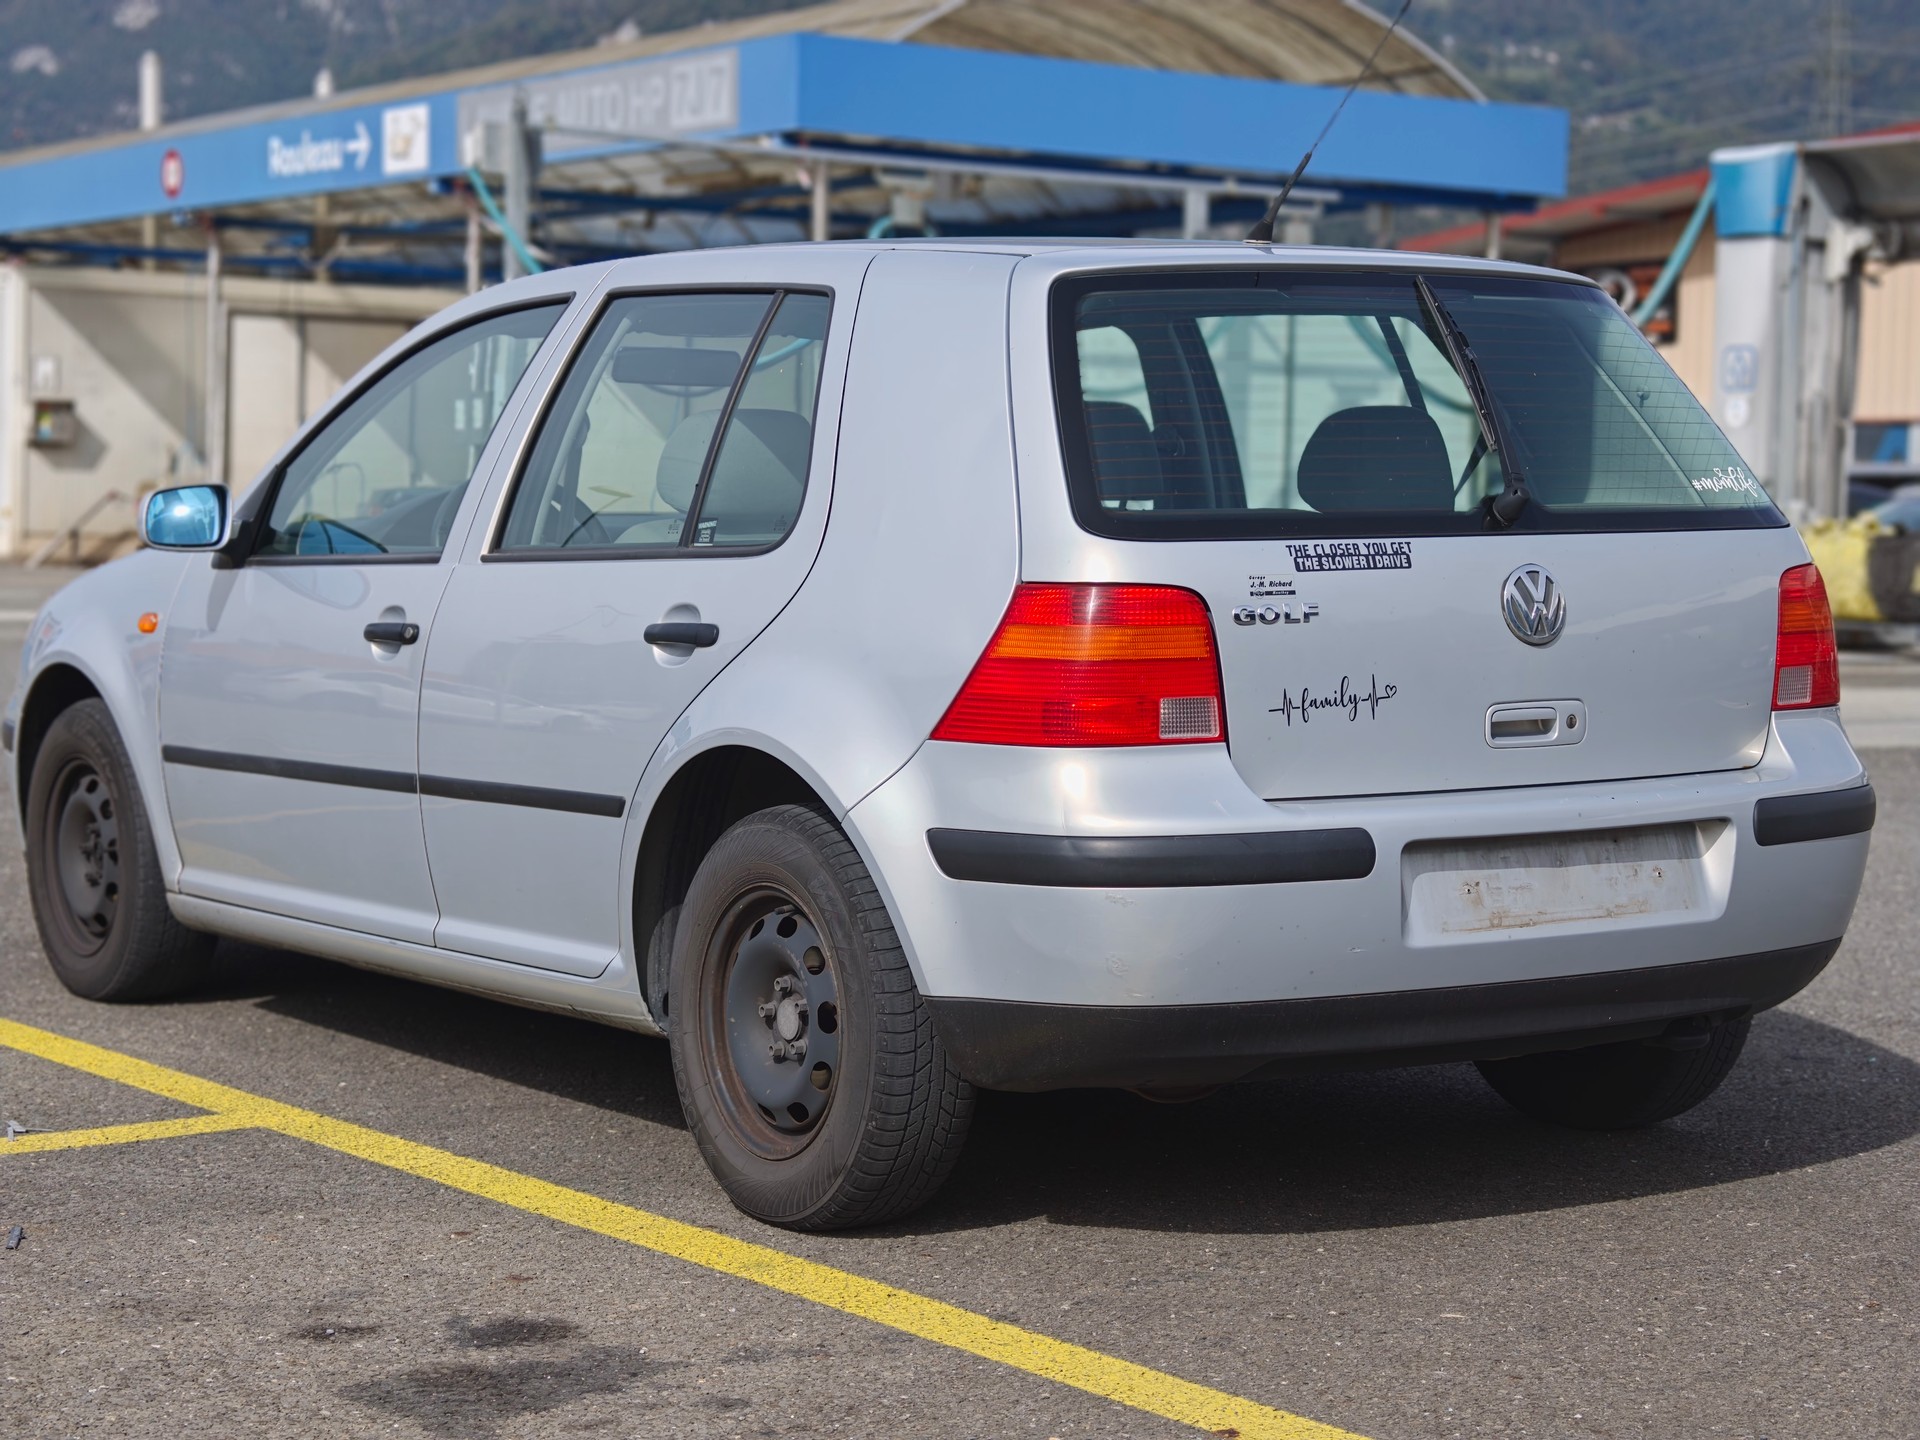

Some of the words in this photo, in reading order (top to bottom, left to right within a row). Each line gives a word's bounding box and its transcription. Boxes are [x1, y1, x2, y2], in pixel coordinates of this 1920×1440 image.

[1285, 544, 1311, 557] THE
[1313, 543, 1360, 556] CLOSER
[1362, 542, 1388, 555] YOU
[1390, 541, 1412, 554] GET
[1297, 557, 1320, 571] THE
[1322, 555, 1368, 570] SLOWER
[1376, 554, 1409, 568] DRIVE
[1269, 580, 1293, 588] Richard
[1231, 602, 1319, 626] GOLF
[1301, 675, 1361, 724] family
[669, 990, 702, 1140] YOKOHAMA
